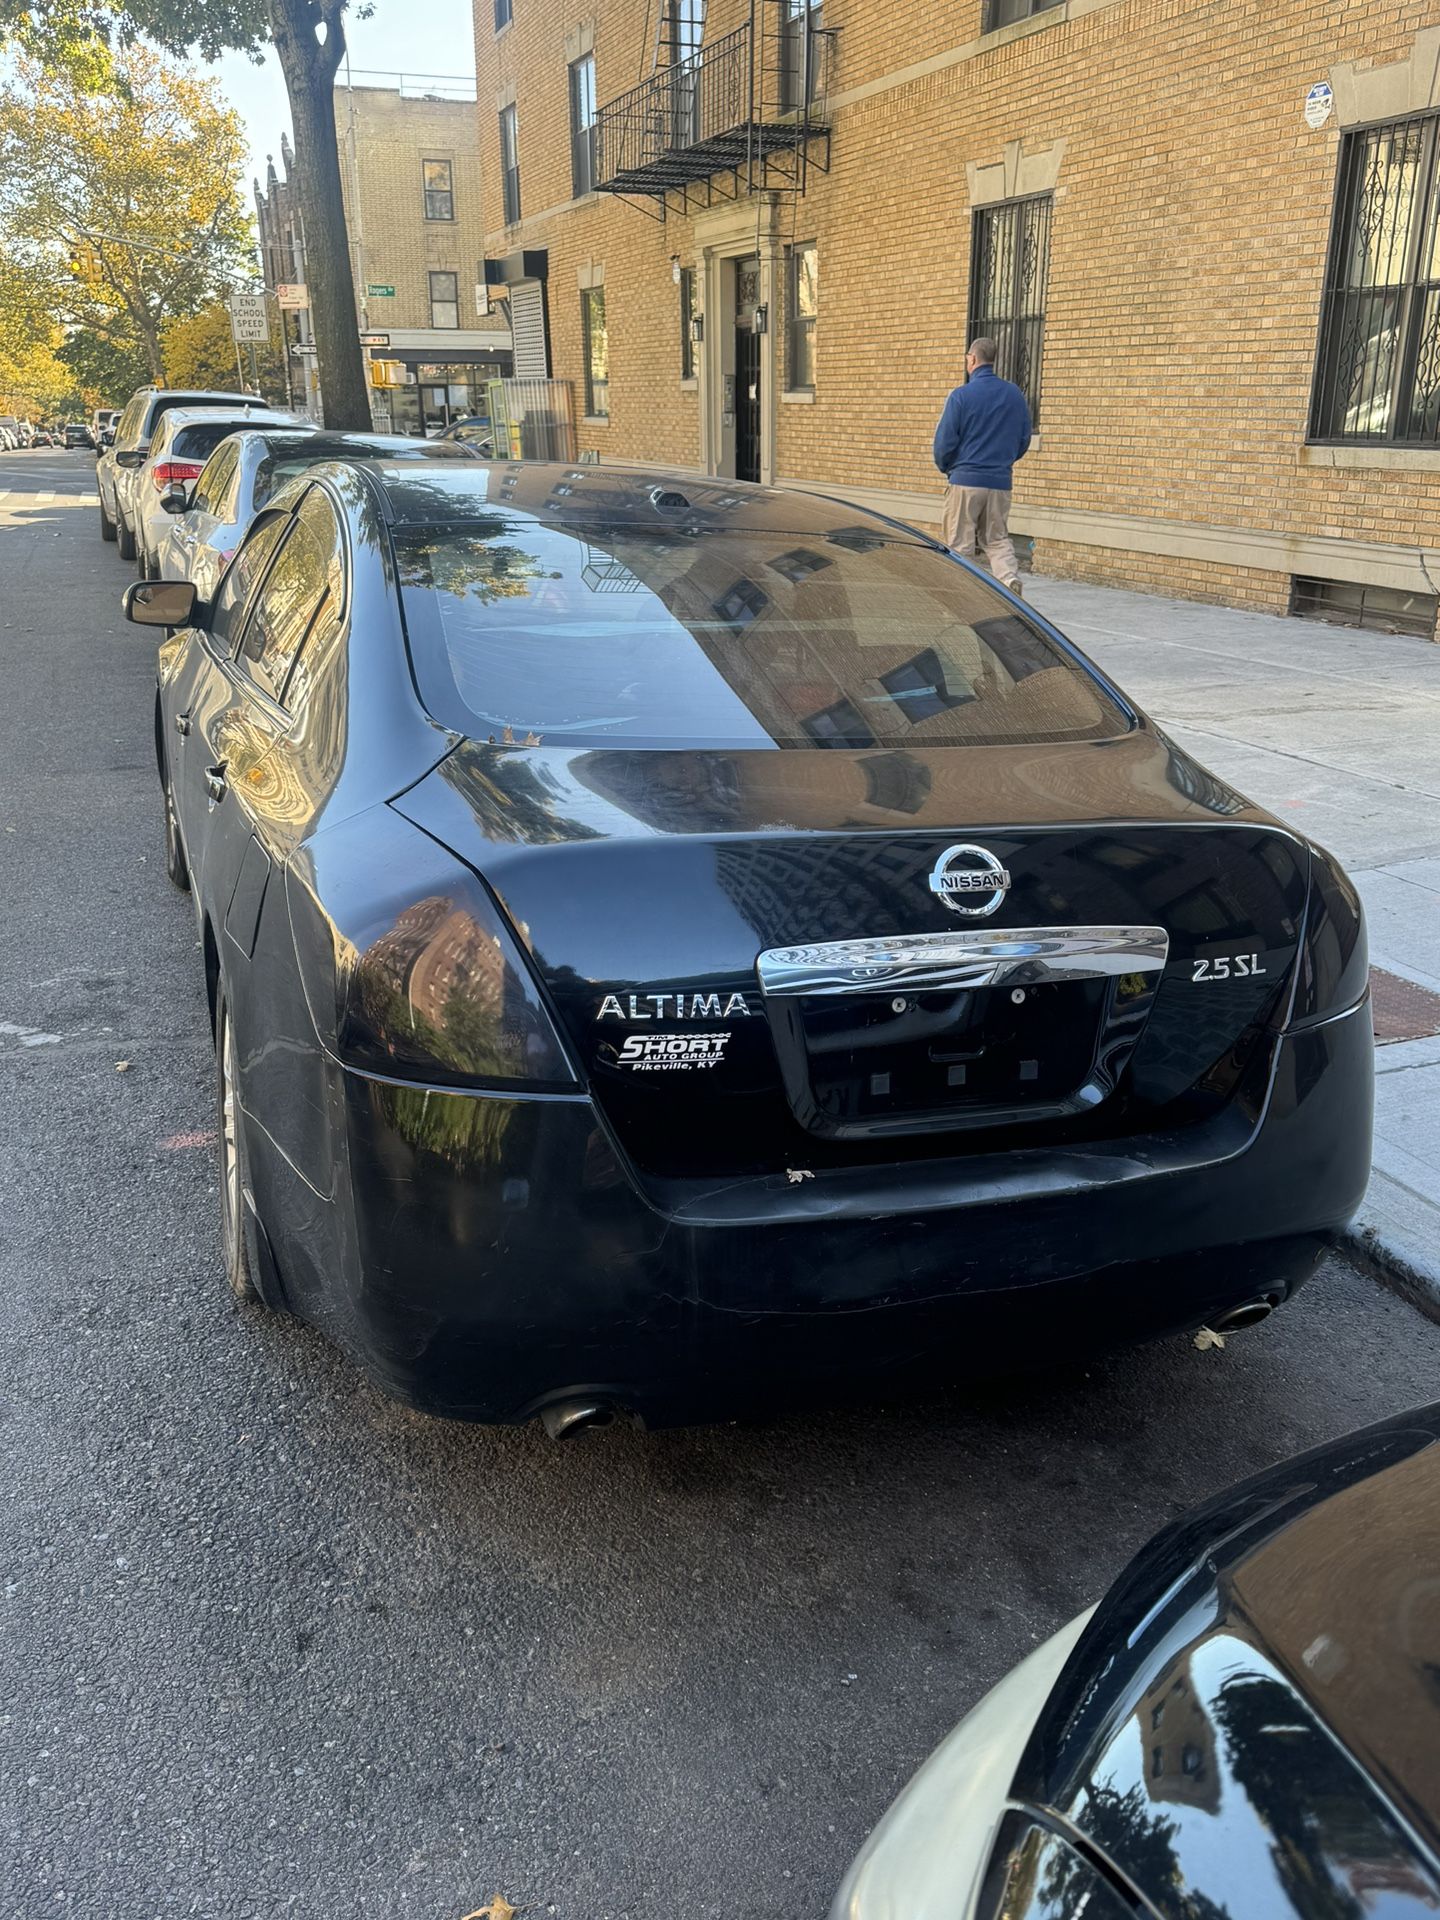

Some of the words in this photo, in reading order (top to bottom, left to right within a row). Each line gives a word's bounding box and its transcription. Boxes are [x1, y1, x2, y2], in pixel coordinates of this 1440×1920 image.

[240, 298, 257, 307] END
[233, 309, 265, 317] SCHOOL
[237, 319, 264, 328] SPEED
[240, 330, 261, 338] LIMIT
[940, 874, 1004, 888] NISSAN
[1192, 957, 1230, 982] 2.5
[1233, 953, 1267, 977] SL
[596, 992, 751, 1020] ALTIMA
[618, 1034, 729, 1059] SHORT
[643, 1053, 678, 1061] AUTO
[681, 1051, 724, 1060] GROUP
[632, 1062, 693, 1071] Pikeville,
[696, 1060, 717, 1069] KY
